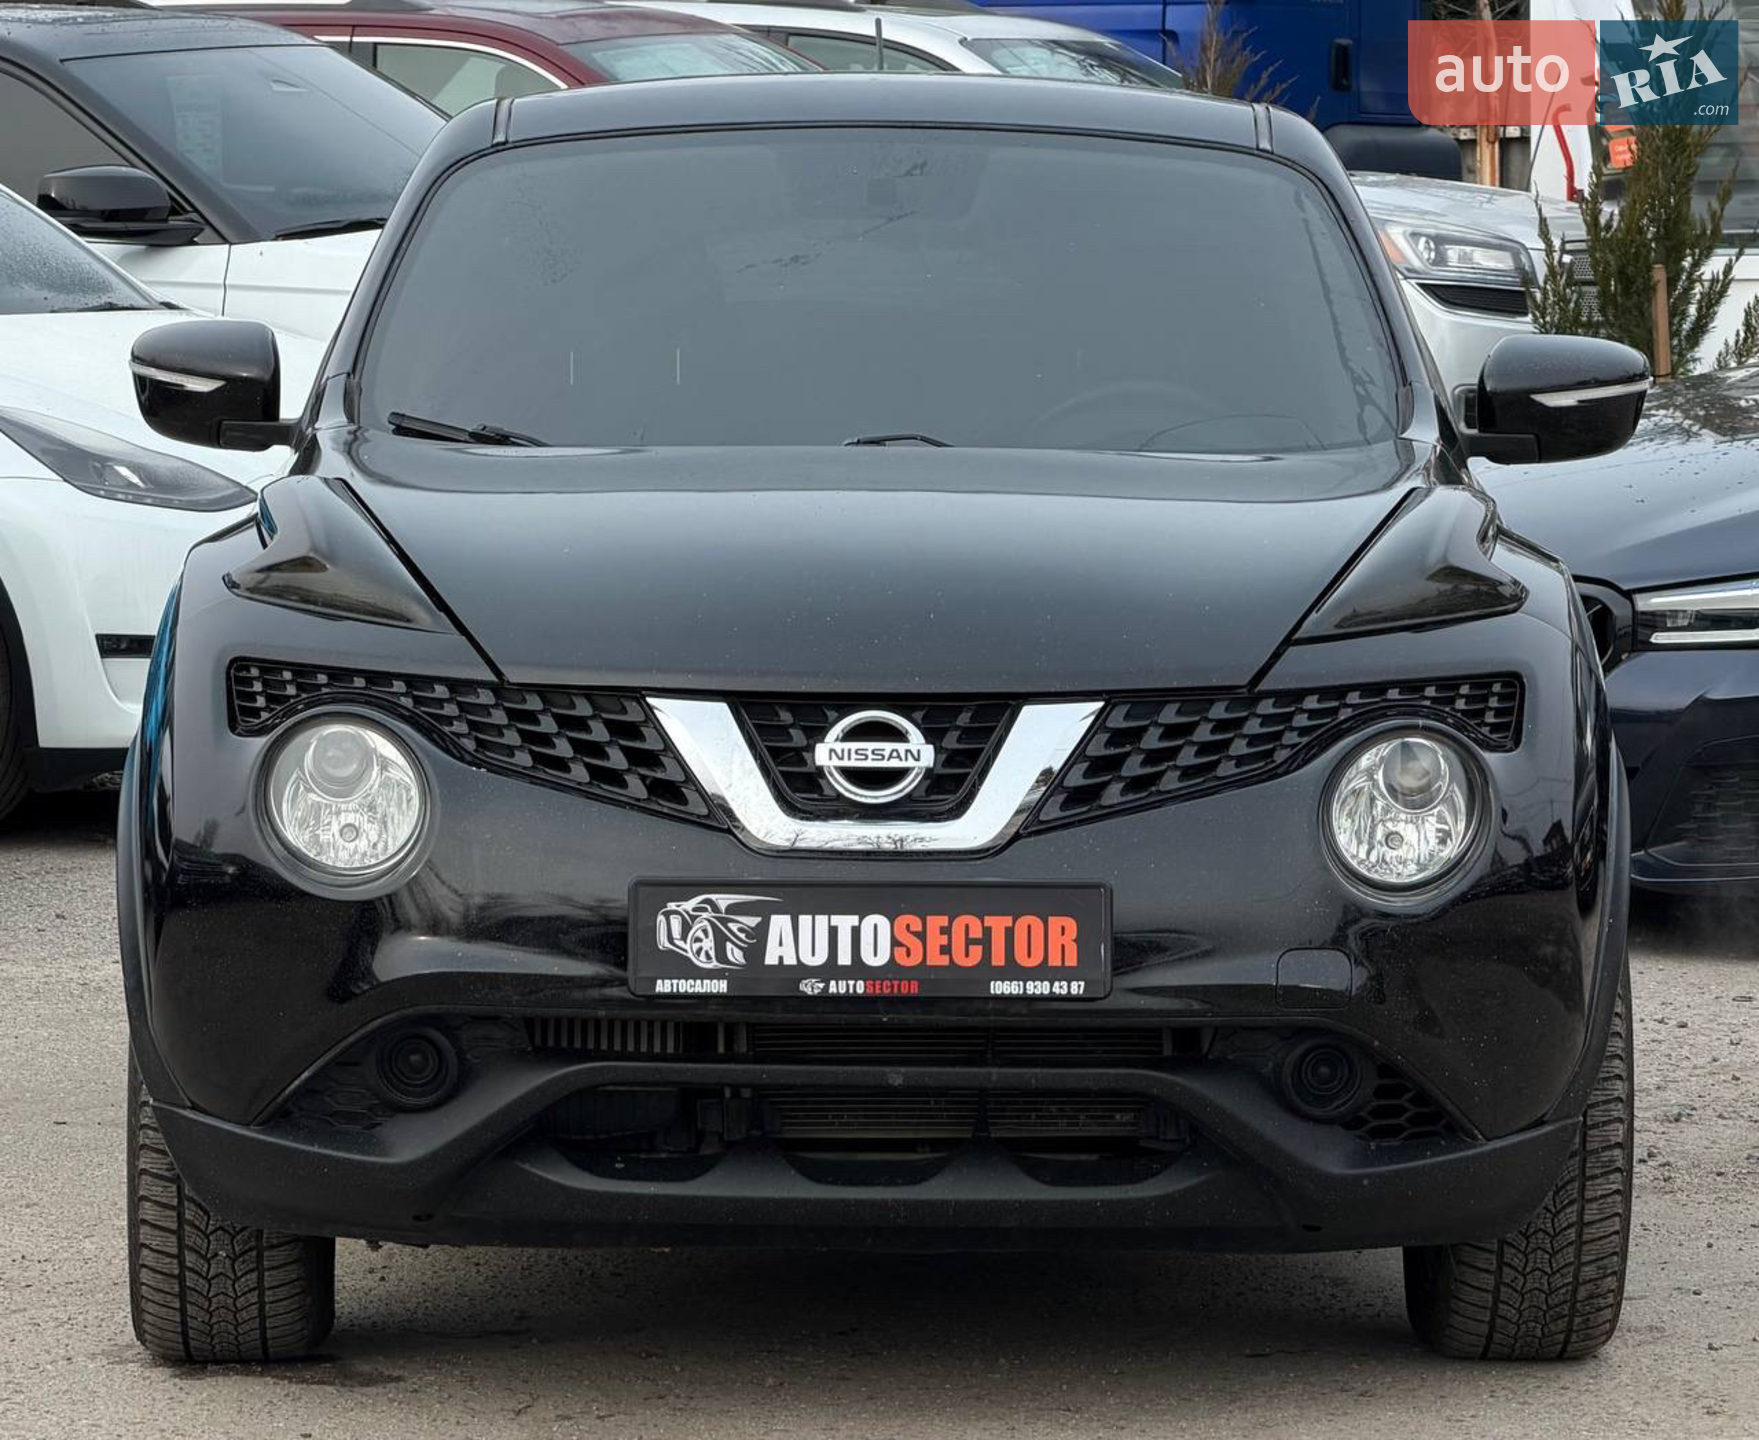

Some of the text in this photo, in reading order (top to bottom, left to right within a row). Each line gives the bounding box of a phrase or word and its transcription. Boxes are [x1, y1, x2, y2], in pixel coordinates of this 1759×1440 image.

[828, 748, 921, 762] NISSAN
[764, 914, 1078, 968] AUTOSECTOR
[655, 979, 728, 993] АВТОСАЛОН
[828, 979, 919, 994] AUTOSECTOR
[990, 980, 1085, 995] (066) 930 43 87
